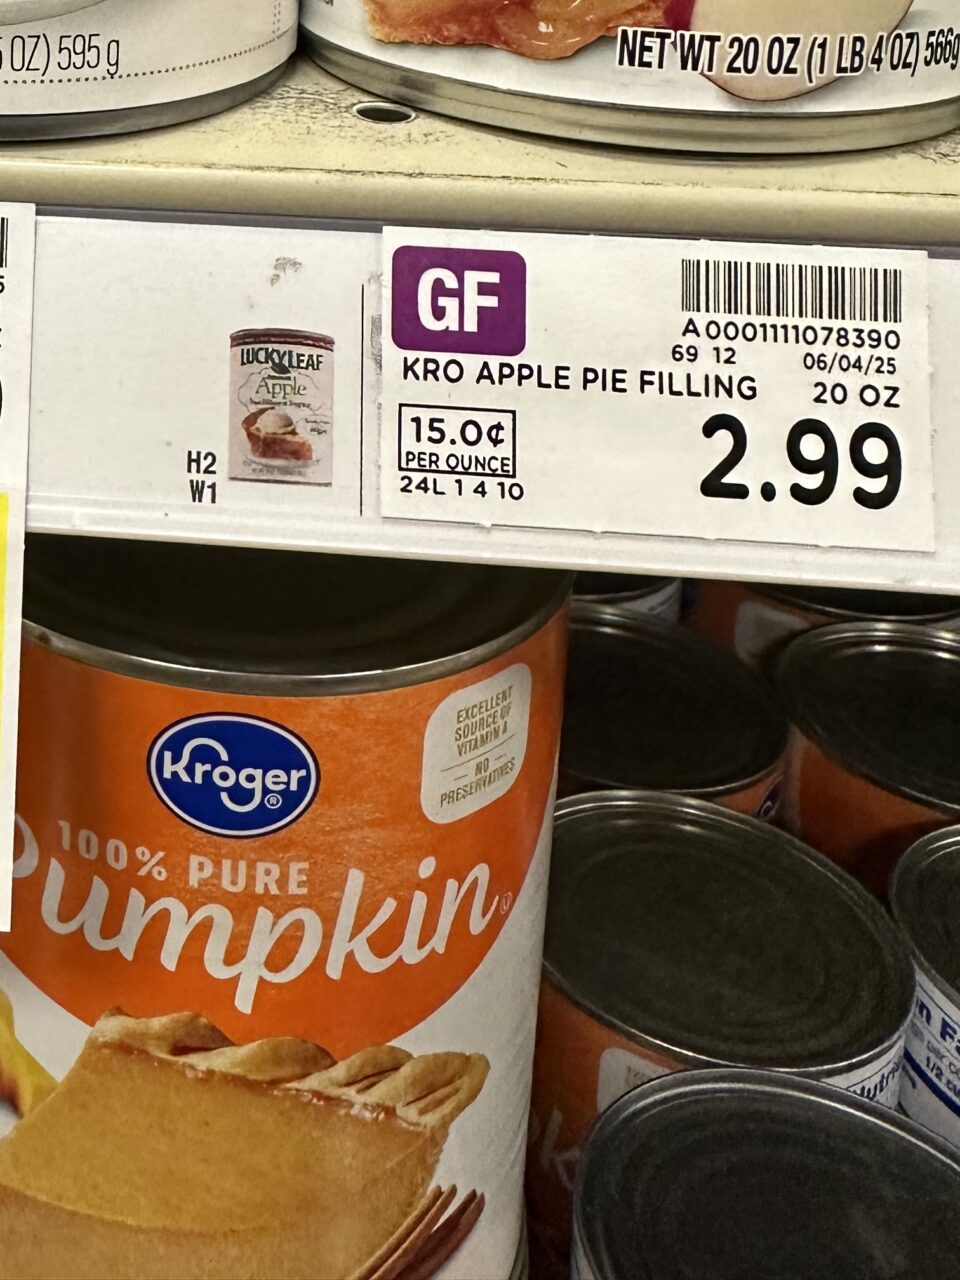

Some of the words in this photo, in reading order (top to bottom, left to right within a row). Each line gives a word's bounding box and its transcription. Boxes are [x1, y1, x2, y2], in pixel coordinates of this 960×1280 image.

[618, 28, 672, 70] NET
[678, 33, 721, 74] WT
[726, 36, 760, 75] 20
[766, 36, 801, 75] OZ
[836, 35, 865, 74] LB
[417, 267, 501, 333] GF
[705, 320, 902, 351] 0001111078390
[803, 352, 897, 375] 06/04/25
[402, 356, 464, 384] KRO
[475, 363, 570, 391] APPLE
[582, 369, 628, 394] PIE
[639, 370, 758, 401] FILLING
[859, 384, 902, 409] OZ
[187, 450, 217, 474] H2
[405, 450, 441, 470] PER
[445, 452, 512, 474] OUNCE
[700, 413, 903, 510] 2.99
[189, 479, 217, 504] W1
[399, 475, 447, 496] 24L
[456, 684, 513, 724] EXCELLENT
[454, 708, 498, 742] SOURCE
[456, 725, 500, 758] VITAMIN
[162, 737, 308, 814] Kroger
[58, 820, 169, 882] 100%
[188, 854, 310, 896] PURE
